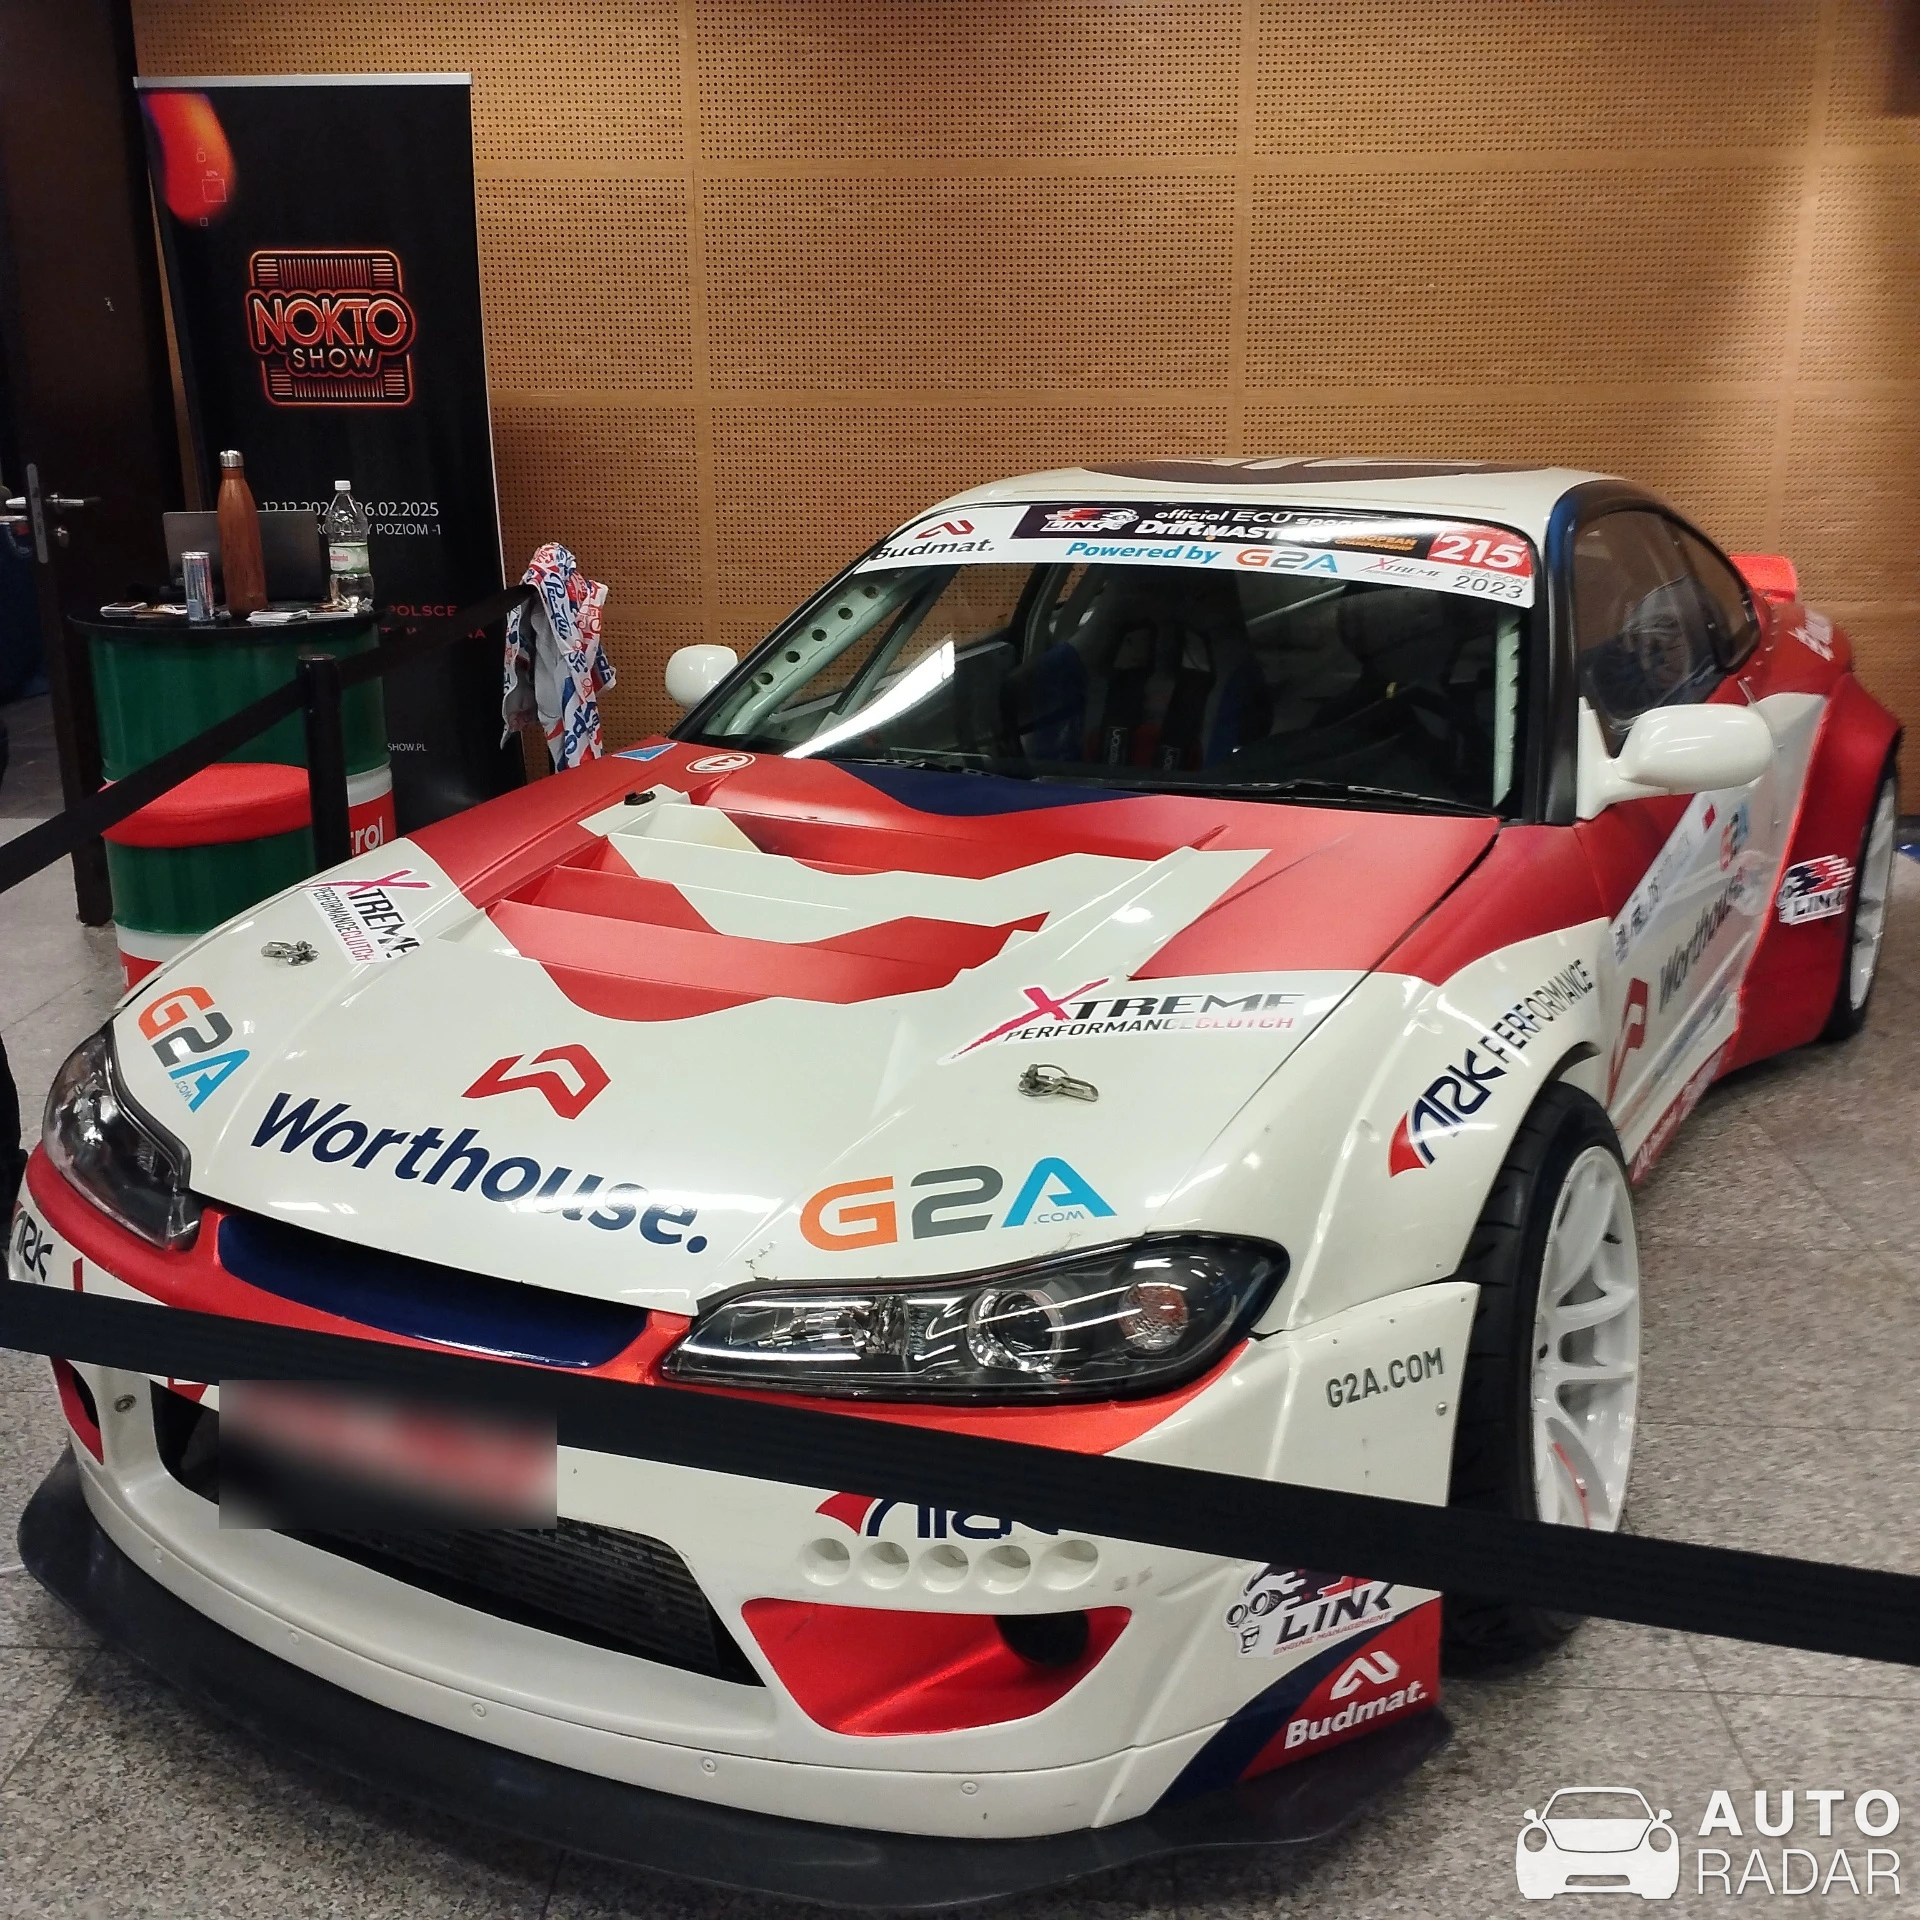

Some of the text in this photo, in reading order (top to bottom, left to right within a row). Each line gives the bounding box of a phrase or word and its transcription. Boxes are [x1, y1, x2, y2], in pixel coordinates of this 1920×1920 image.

[254, 298, 408, 345] NOKTO
[293, 348, 374, 368] SHOW
[376, 523, 429, 536] POZIOM
[432, 523, 442, 536] -1
[1154, 509, 1229, 521] official
[1232, 511, 1293, 524] ECU
[1065, 542, 1338, 573] Powered by G2A
[1430, 535, 1527, 569] 215
[1452, 575, 1523, 599] 2023
[1460, 568, 1528, 586] SEASON
[351, 816, 384, 856] rol
[298, 868, 431, 959] XTREME
[1792, 886, 1846, 918] LINK
[950, 977, 1306, 1060] XTREME
[138, 985, 251, 1114] G2A
[1392, 959, 1595, 1174] ARK PERFORMANCE
[250, 1091, 709, 1255] Worthouse.
[799, 1156, 1119, 1252] G2A
[1033, 1210, 1086, 1225] .COM
[1325, 1346, 1445, 1409] G2A.COM
[1273, 1611, 1392, 1657] ENGINE MANAGEMENT
[1276, 1583, 1395, 1645] LINK
[1284, 1680, 1430, 1750] Budmat.
